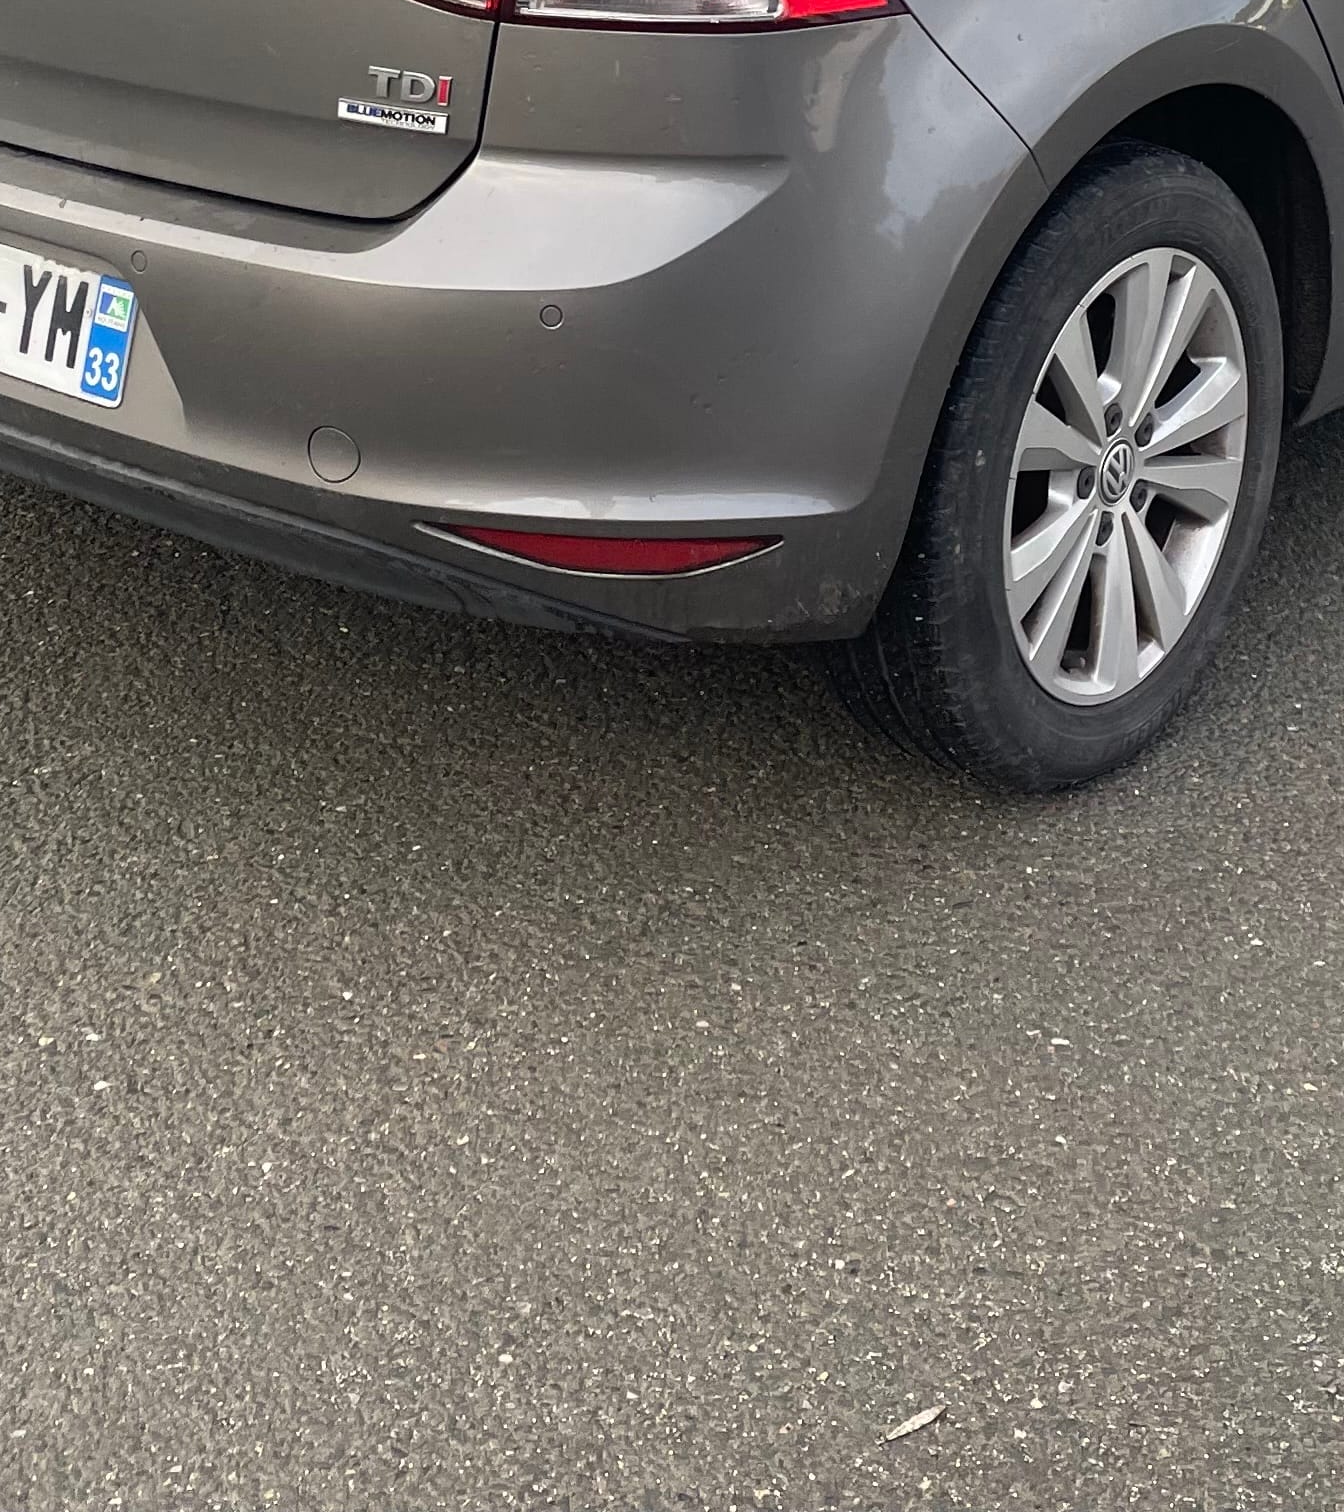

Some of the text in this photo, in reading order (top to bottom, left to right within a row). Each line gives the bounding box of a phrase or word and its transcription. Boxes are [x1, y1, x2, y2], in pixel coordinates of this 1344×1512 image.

[367, 65, 452, 106] TDI
[346, 103, 436, 126] BLUEMOTION
[84, 346, 120, 391] 33
